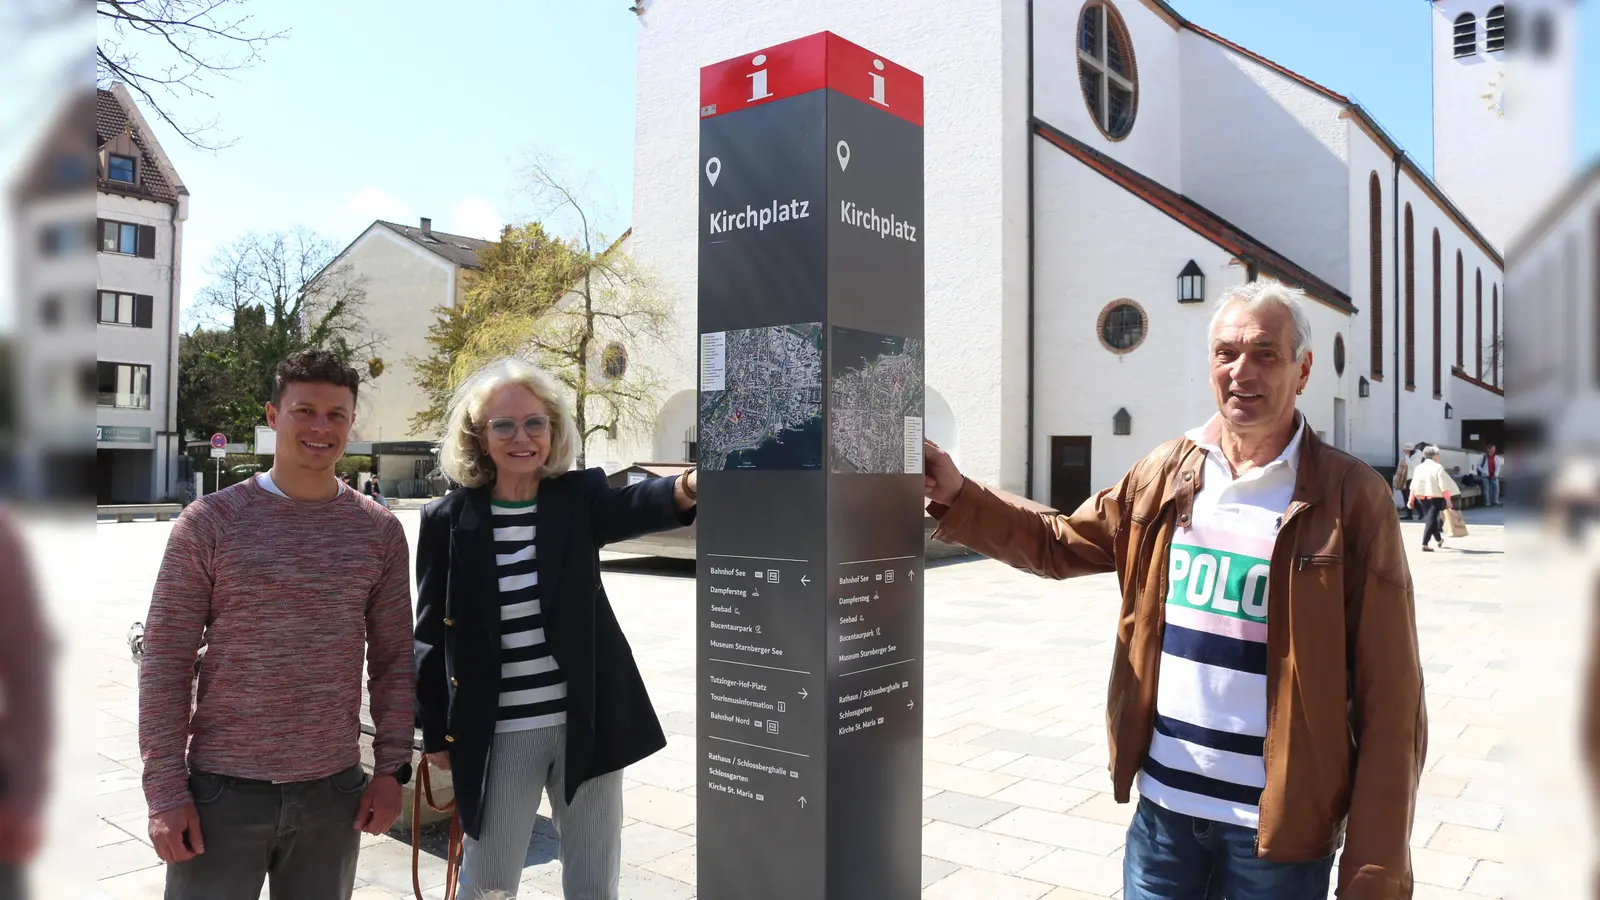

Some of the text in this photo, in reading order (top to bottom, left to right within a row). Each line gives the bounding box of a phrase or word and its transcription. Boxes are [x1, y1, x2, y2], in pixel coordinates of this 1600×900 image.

[710, 199, 810, 234] Kirchplatz
[840, 200, 917, 242] Kirchplatz
[710, 567, 746, 577] Bahnhof See
[839, 576, 860, 585] Bahnhof
[1166, 548, 1271, 618] POLO
[710, 586, 747, 598] Dampfersteg
[839, 595, 870, 605] Dampfersteg
[710, 604, 732, 613] Seebad
[710, 621, 753, 633] Bucentaurpark
[839, 615, 858, 625] Seebad
[839, 629, 874, 643] Bucentaurpark
[710, 640, 783, 656] Museum Starnberger See
[839, 644, 897, 662] Museum Starnberger See
[710, 675, 767, 692] Tutzinger-Hof-Platz
[839, 693, 859, 704] Rathaus
[863, 682, 901, 698] Schlossberghalle
[710, 693, 774, 710] Tourismusinformation
[710, 711, 750, 726] Bahnhof Nord
[839, 706, 873, 720] Schlossgarten
[839, 726, 855, 736] Kirche
[862, 719, 876, 729] Maria
[708, 752, 732, 765] Rathaus
[736, 758, 787, 776] Schlossberghalle
[708, 767, 749, 783] Schlossgarten
[708, 782, 754, 799] Kirche St. Maria
